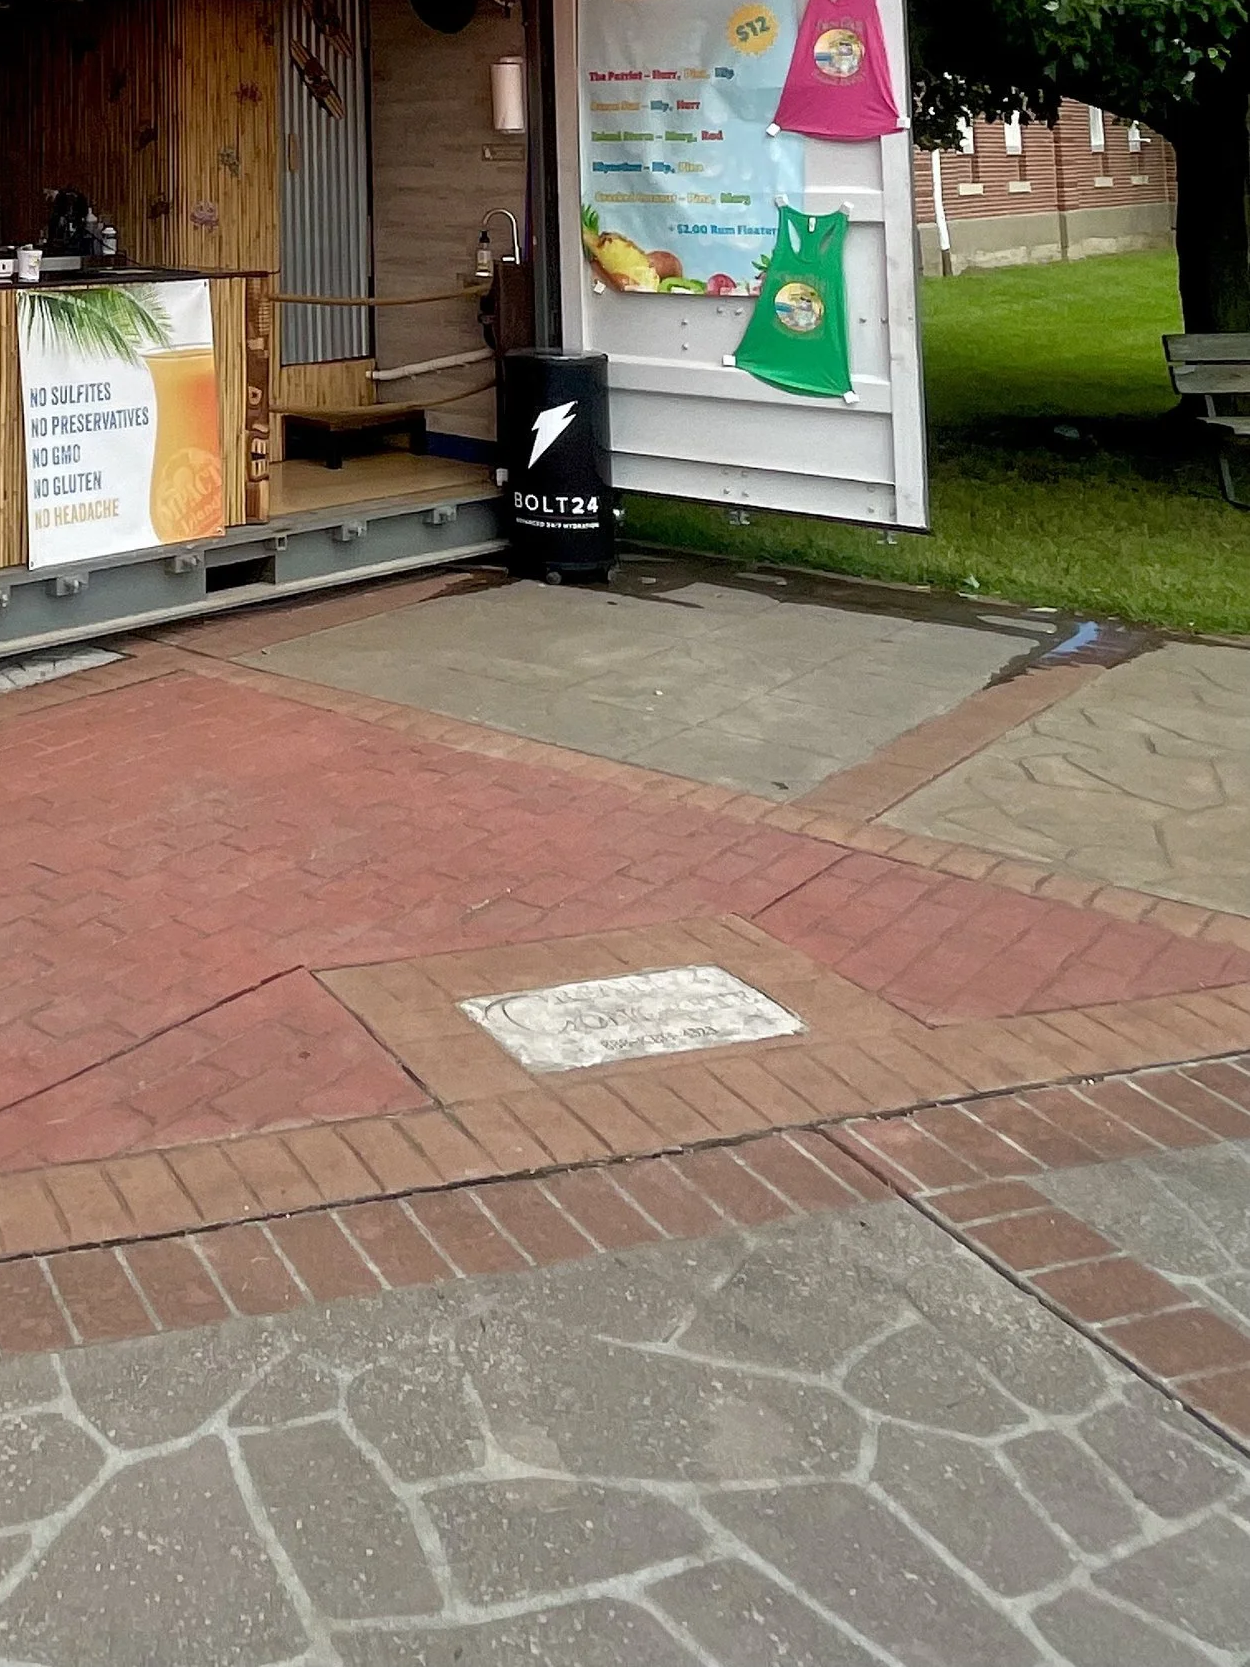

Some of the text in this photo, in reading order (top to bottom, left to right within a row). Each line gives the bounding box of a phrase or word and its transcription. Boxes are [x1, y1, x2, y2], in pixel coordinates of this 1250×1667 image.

[735, 14, 770, 42] $12
[710, 224, 735, 235] Rum
[30, 382, 111, 408] NO SULFITES
[31, 406, 149, 438] NO PRESERVATIVES
[32, 444, 81, 469] NO GMO
[34, 470, 102, 499] NO GLUTEN
[34, 497, 120, 530] NO HEADACHE
[514, 491, 600, 515] BOLT24
